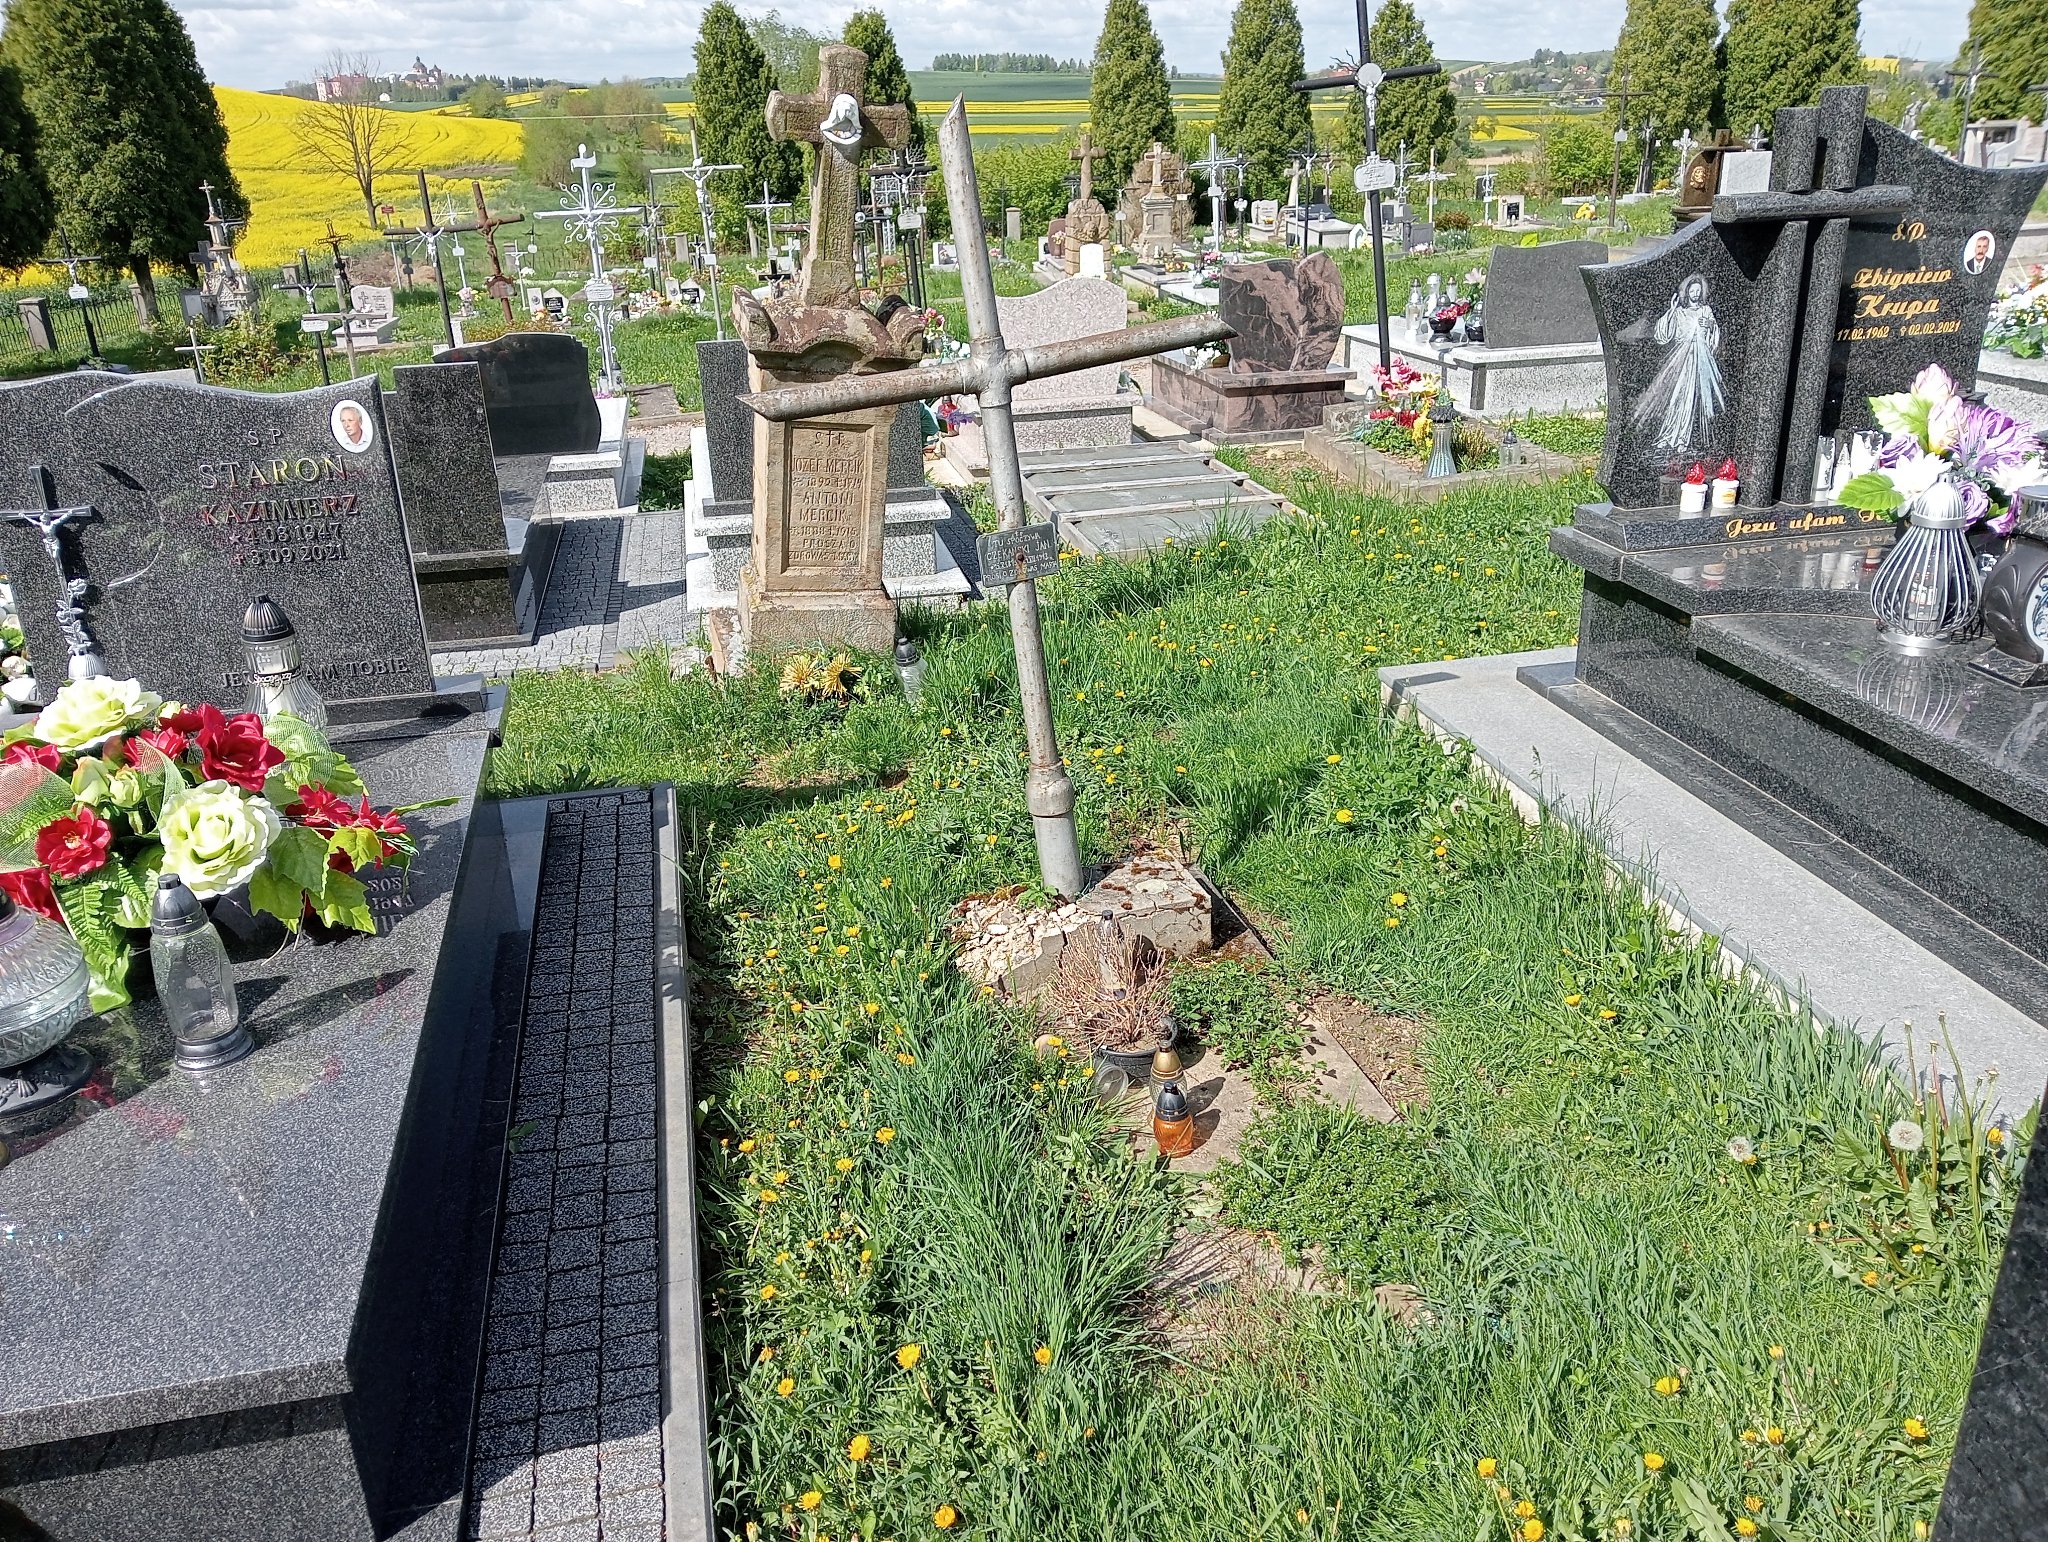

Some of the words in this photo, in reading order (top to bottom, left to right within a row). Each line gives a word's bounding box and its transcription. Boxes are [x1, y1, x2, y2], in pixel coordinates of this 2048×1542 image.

[1851, 265, 1953, 291] Zbigniew
[1854, 294, 1940, 320] Krupa
[1836, 326, 1890, 341] 17.02.1962
[1908, 320, 1961, 336] 02.02.2021
[269, 429, 281, 445] P
[199, 494, 359, 526] KAZIMIERZ
[295, 522, 341, 541] 1947
[1725, 518, 1777, 538] Jezu
[1789, 512, 1847, 531] ufam
[300, 543, 346, 561] 2021
[350, 657, 409, 678] TOBIE
